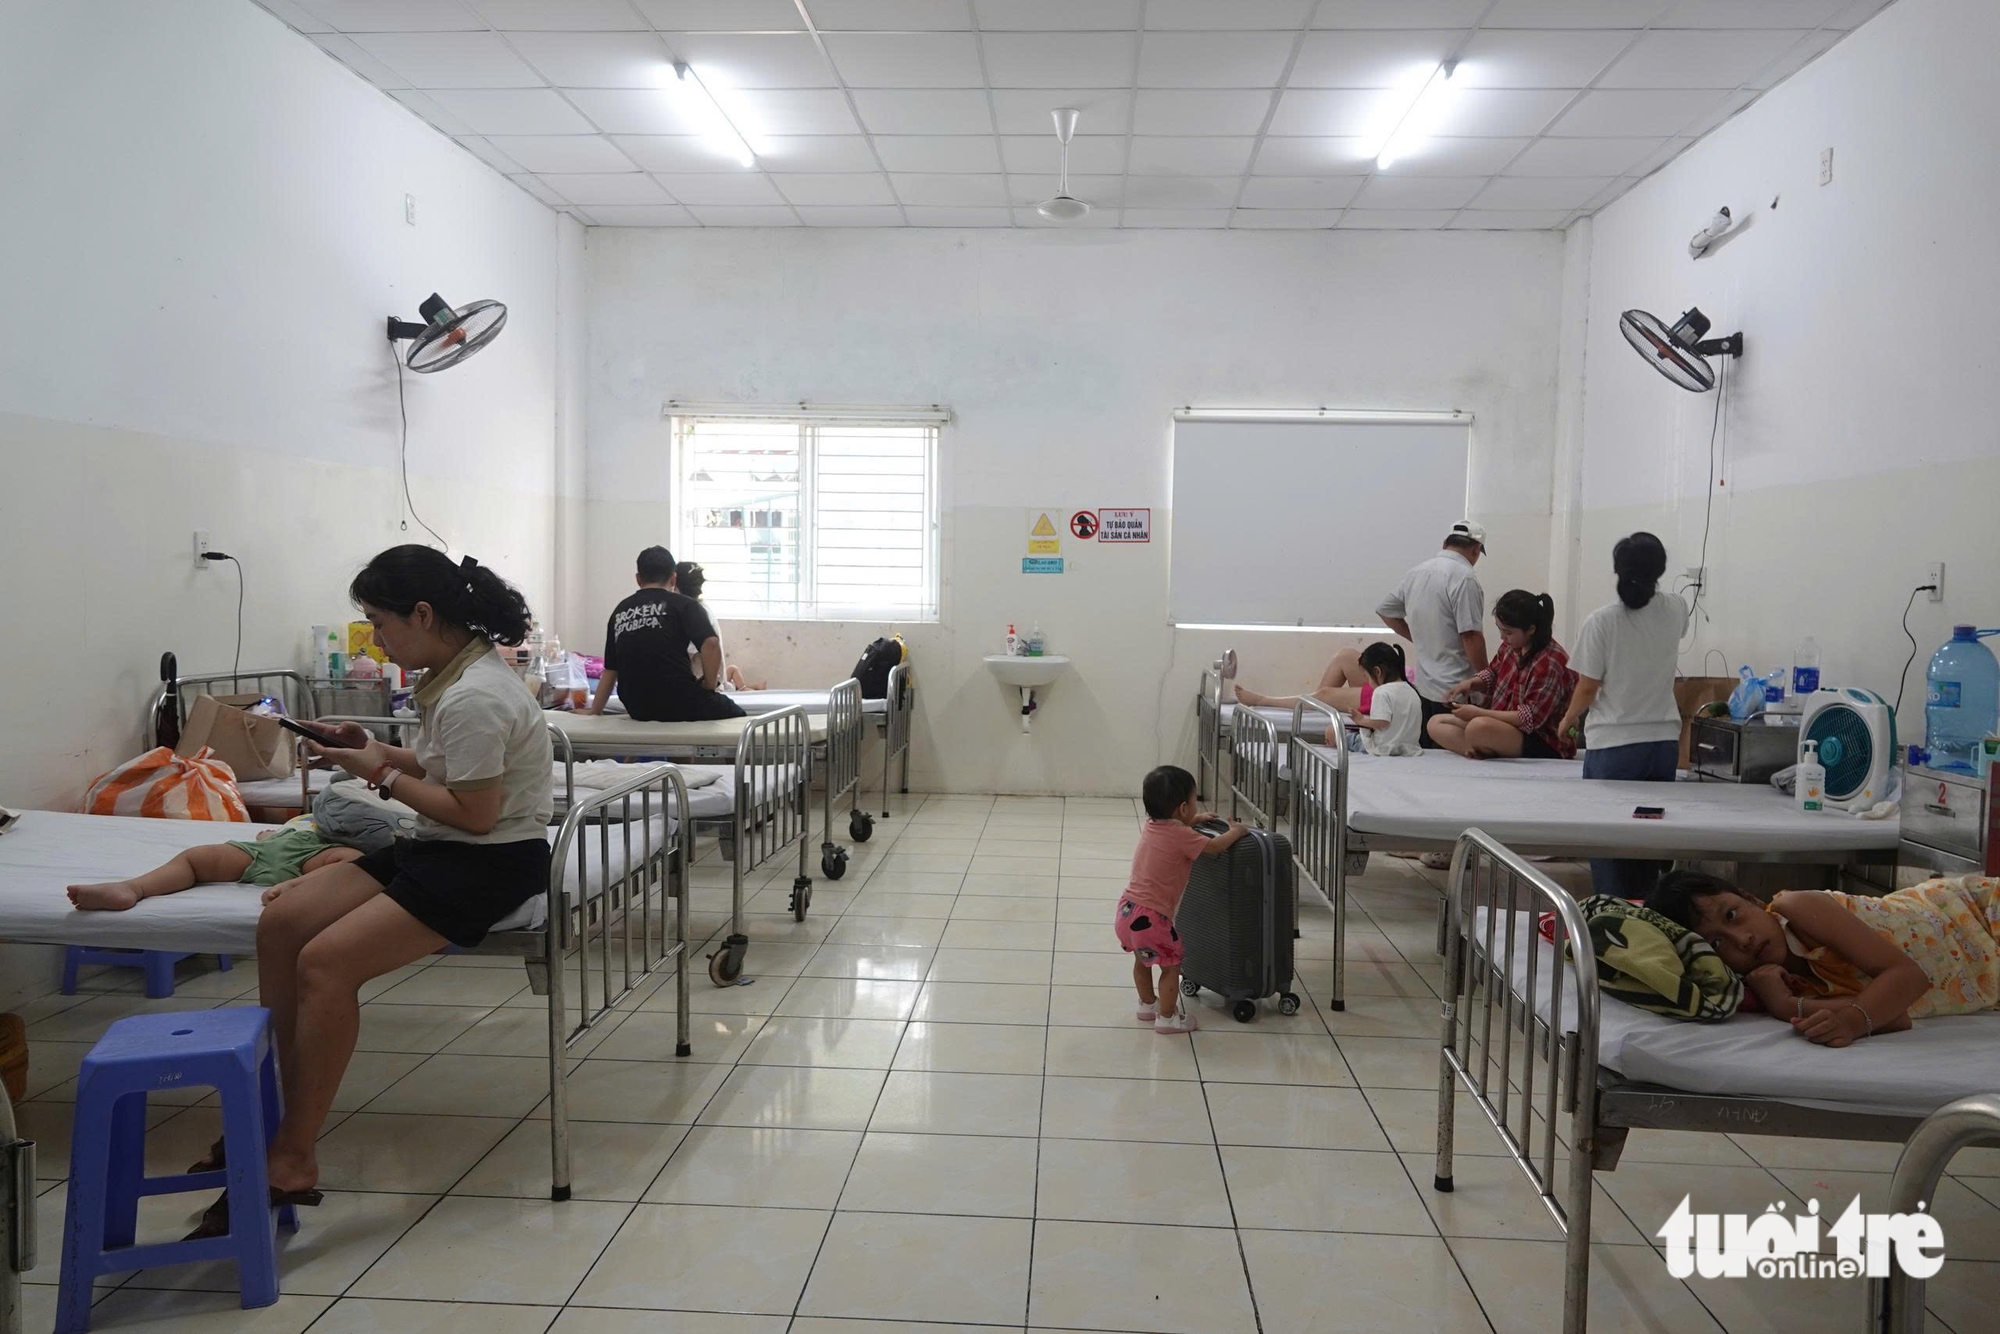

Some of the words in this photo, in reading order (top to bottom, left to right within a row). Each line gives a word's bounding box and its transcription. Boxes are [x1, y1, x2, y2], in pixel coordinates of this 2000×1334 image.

[1114, 518, 1126, 529] BẢO
[1127, 518, 1143, 529] QUẢN
[1100, 530, 1109, 539] TÀI
[1110, 529, 1122, 539] SẢN
[1123, 530, 1131, 539] CÁ
[1132, 530, 1149, 539] NHÂN
[1938, 782, 1947, 804] 2
